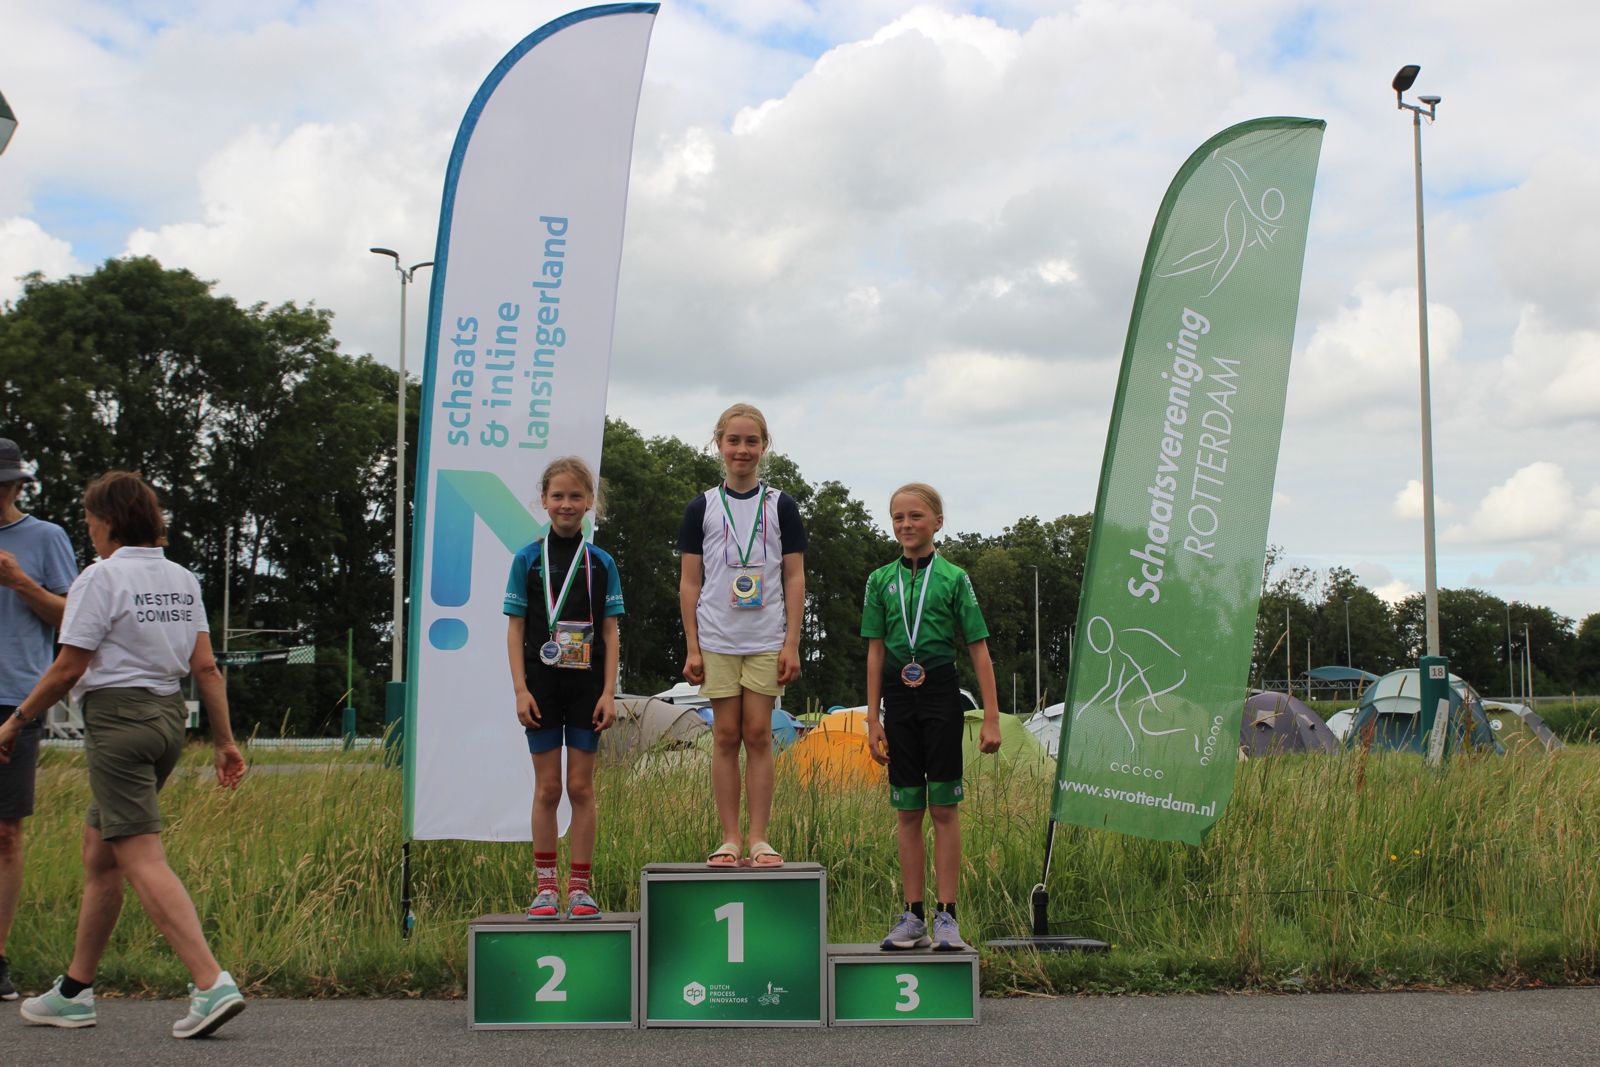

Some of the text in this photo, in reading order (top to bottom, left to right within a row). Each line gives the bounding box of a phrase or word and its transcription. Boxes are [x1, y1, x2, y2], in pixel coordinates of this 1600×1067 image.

[518, 215, 569, 450] lansingerland
[442, 316, 478, 446] schaats
[480, 302, 520, 448] & inline
[1128, 306, 1211, 604] Schaatsvereniging
[1183, 356, 1241, 559] ROTTERDAM
[226, 653, 256, 663] START
[1431, 667, 1444, 677] 18
[1058, 779, 1216, 817] www.svrotterdam.nl
[714, 902, 744, 963] 1
[535, 955, 567, 1001] 2
[895, 973, 920, 1011] 3
